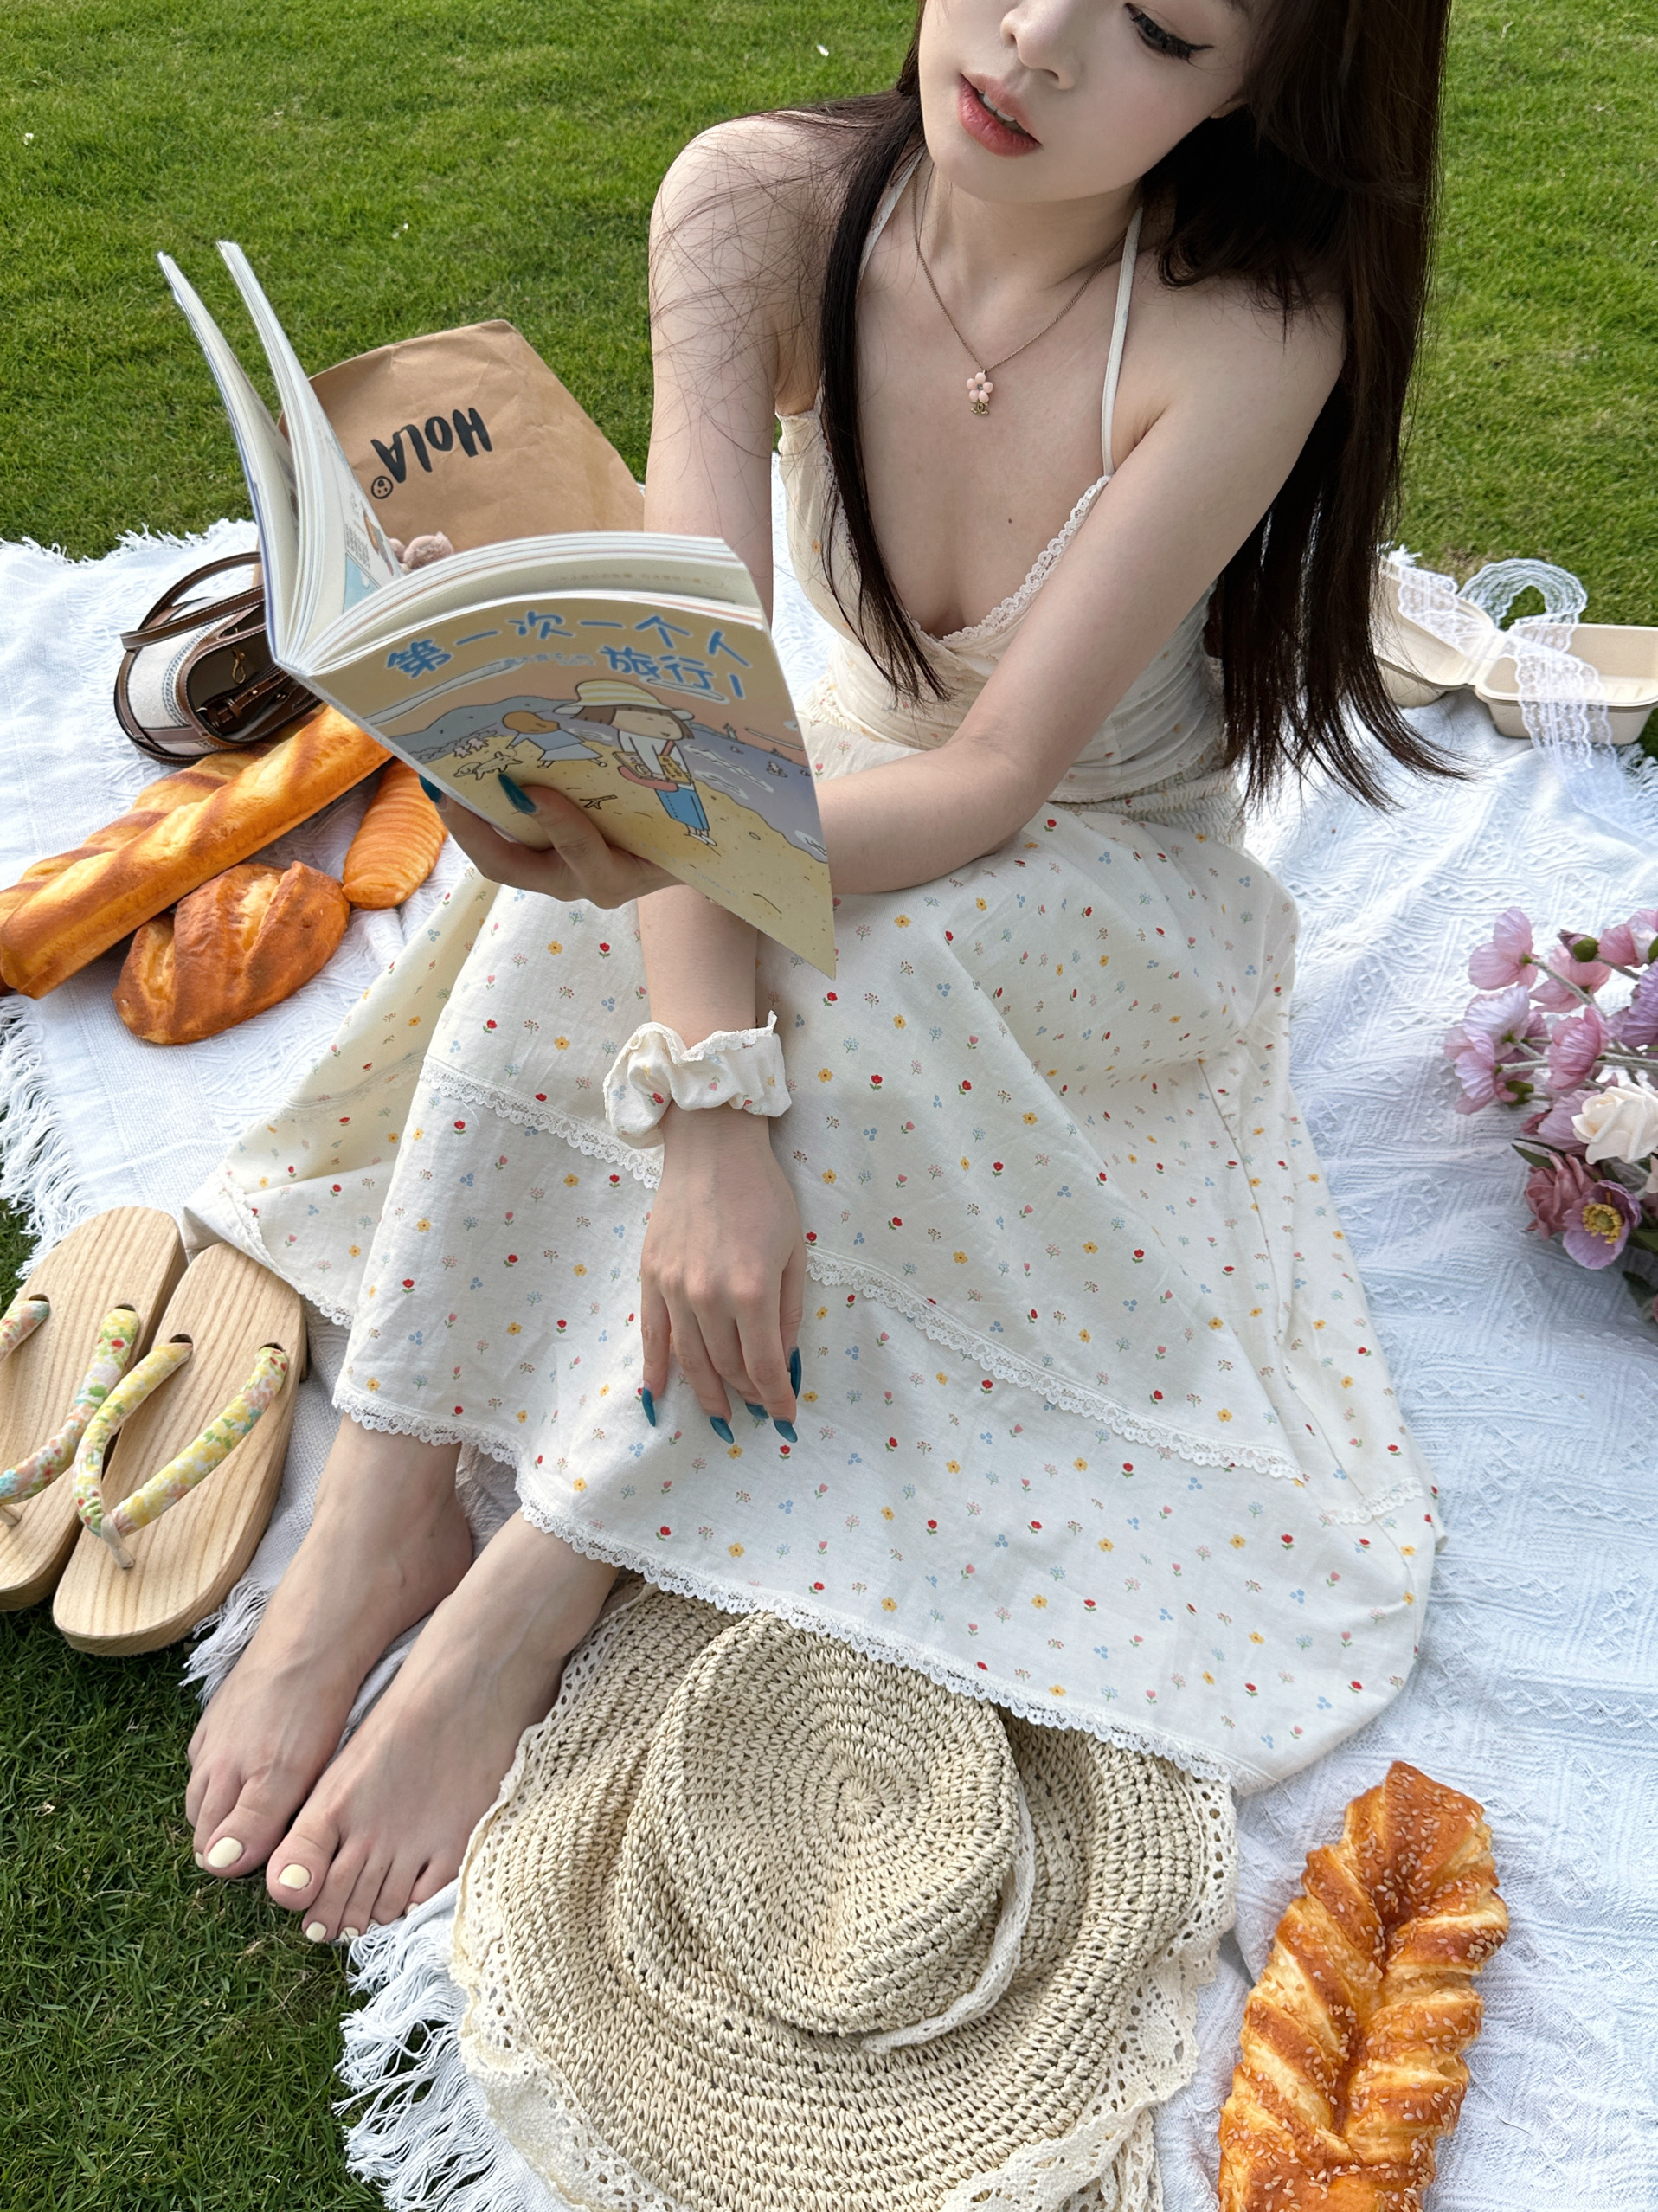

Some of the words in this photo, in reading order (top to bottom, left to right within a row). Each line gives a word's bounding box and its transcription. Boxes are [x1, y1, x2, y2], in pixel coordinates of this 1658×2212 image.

[386, 610, 750, 678] 第一次一个人
